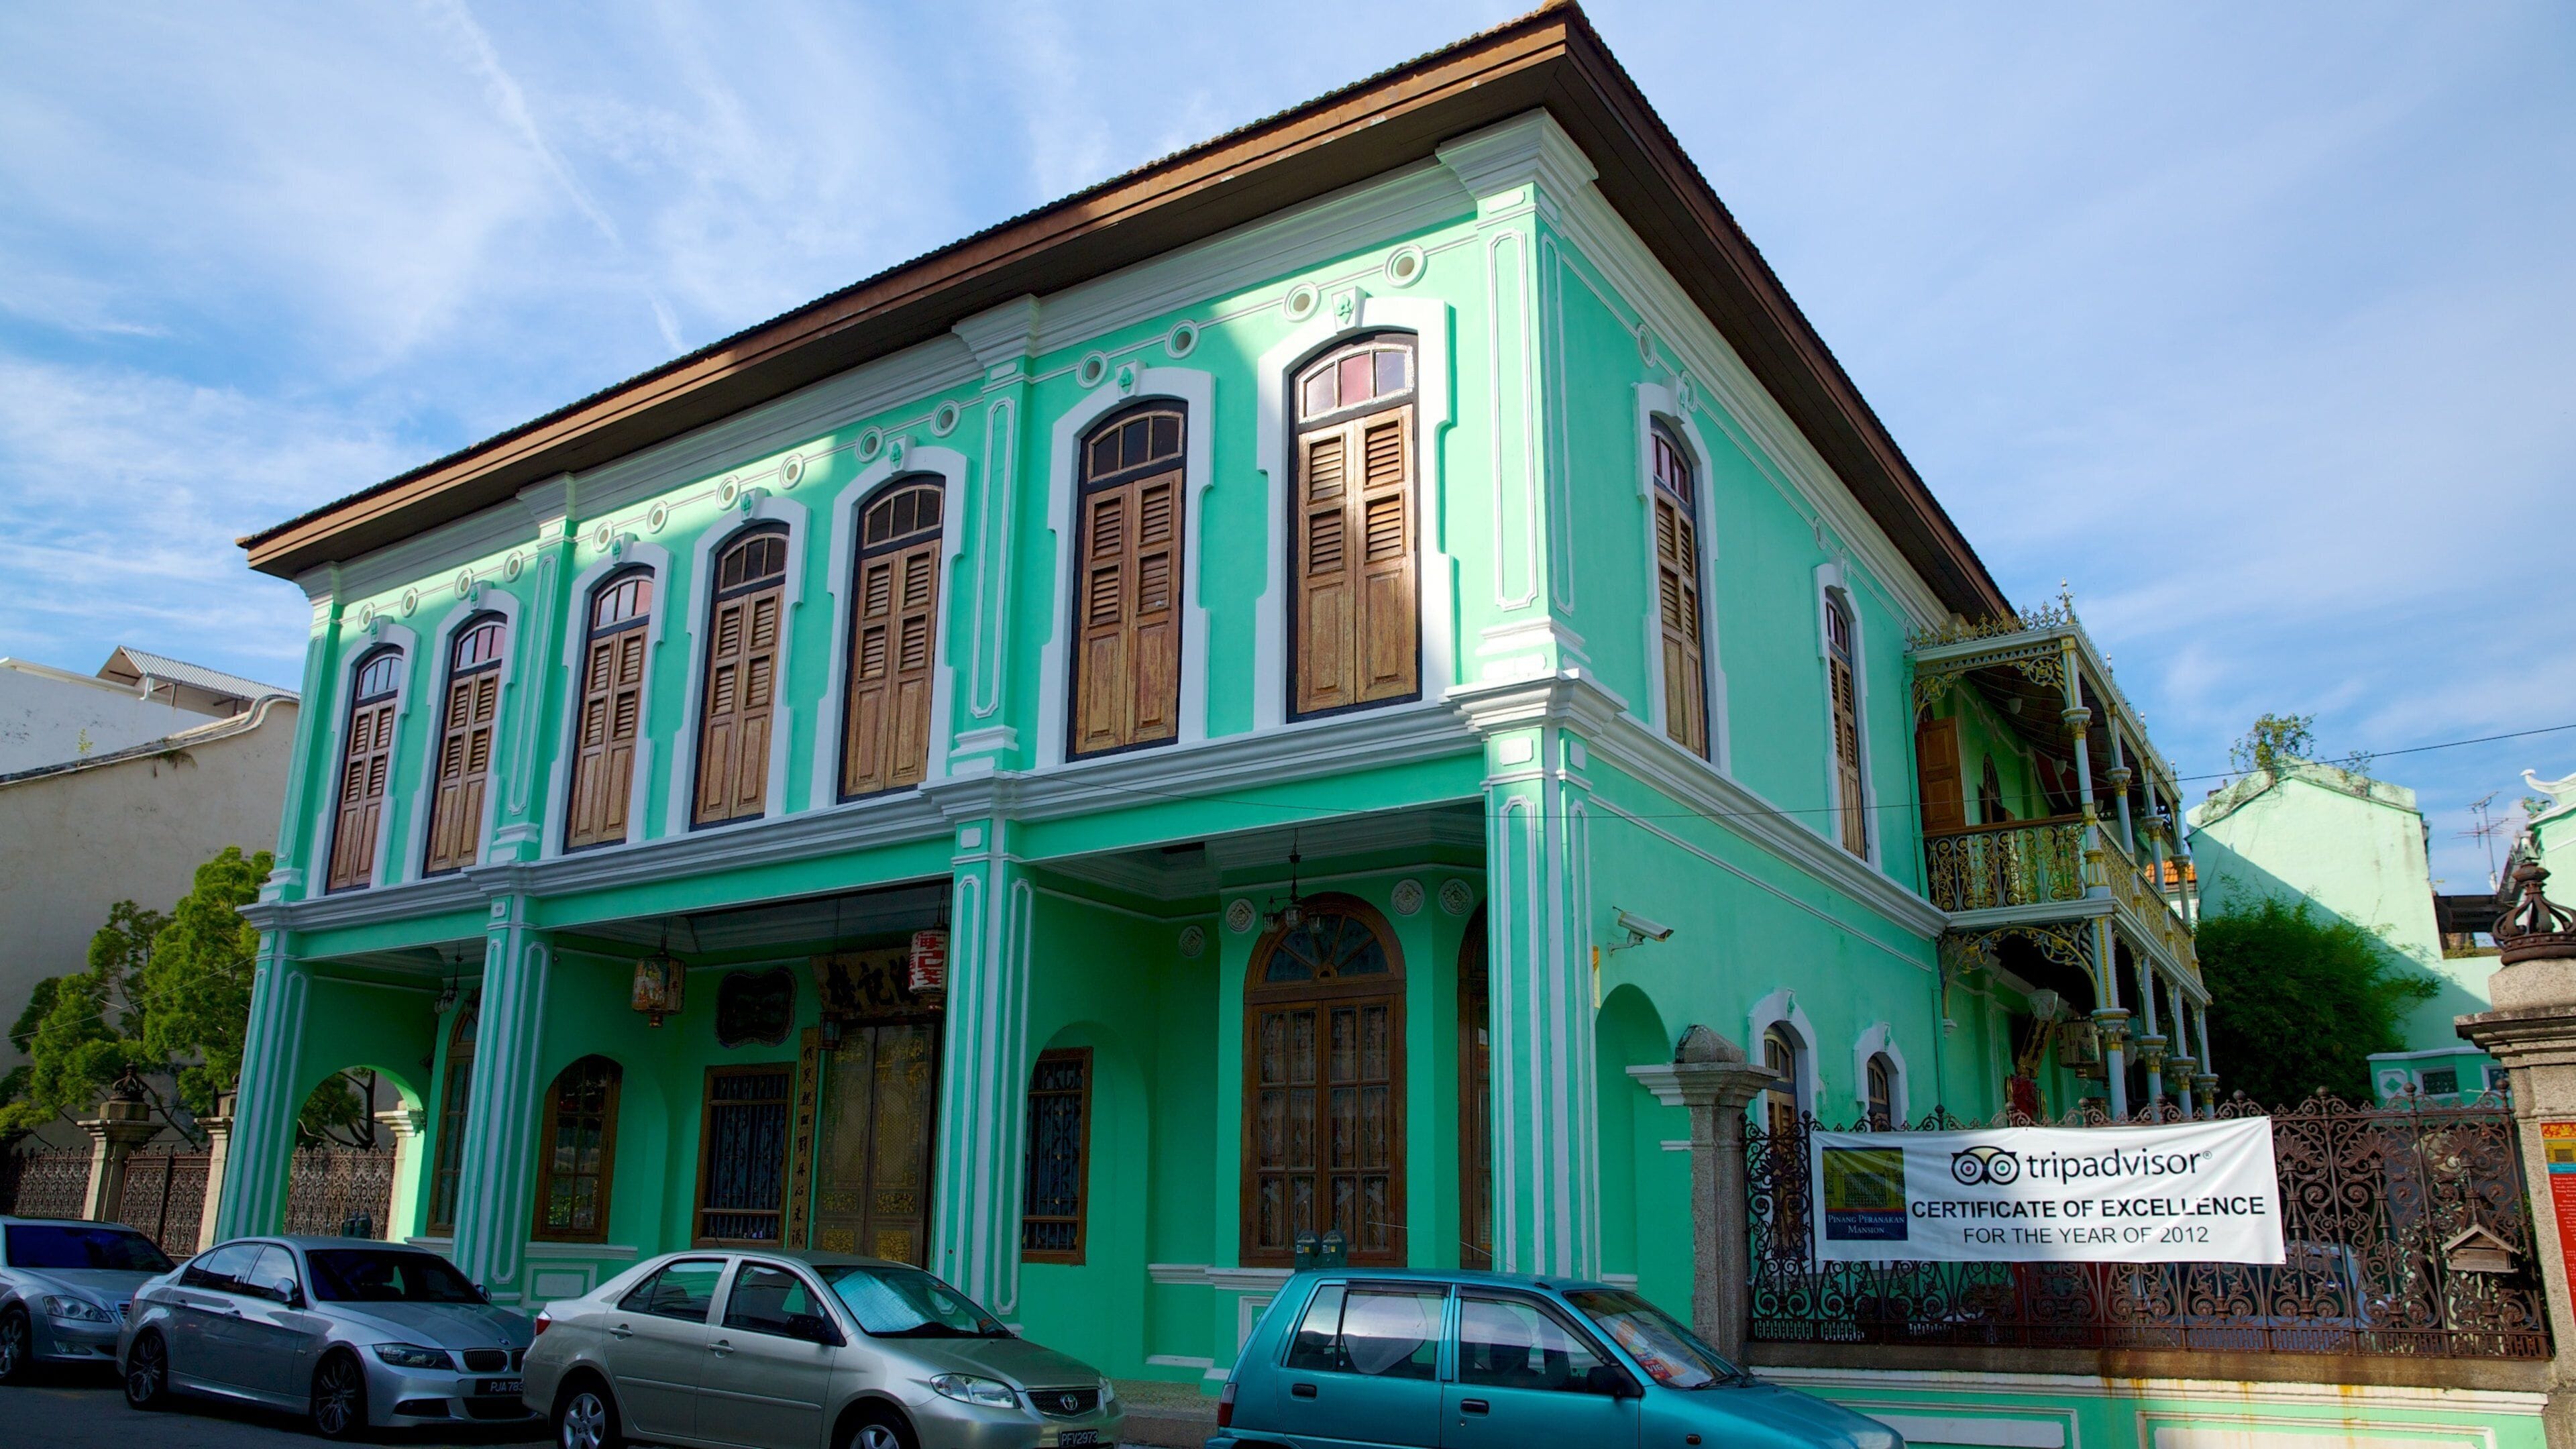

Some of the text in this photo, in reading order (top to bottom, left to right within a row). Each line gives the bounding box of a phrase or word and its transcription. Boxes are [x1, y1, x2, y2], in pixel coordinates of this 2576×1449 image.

[1912, 1196, 2265, 1218] CERTIFICATE OF EXCELLENCE
[1828, 1214, 1905, 1224] PINANG PERANAKAN
[1847, 1225, 1885, 1234] MANSION
[1964, 1226, 2209, 1244] FOR THE YEAR OF 2012
[490, 1382, 506, 1392] PJA
